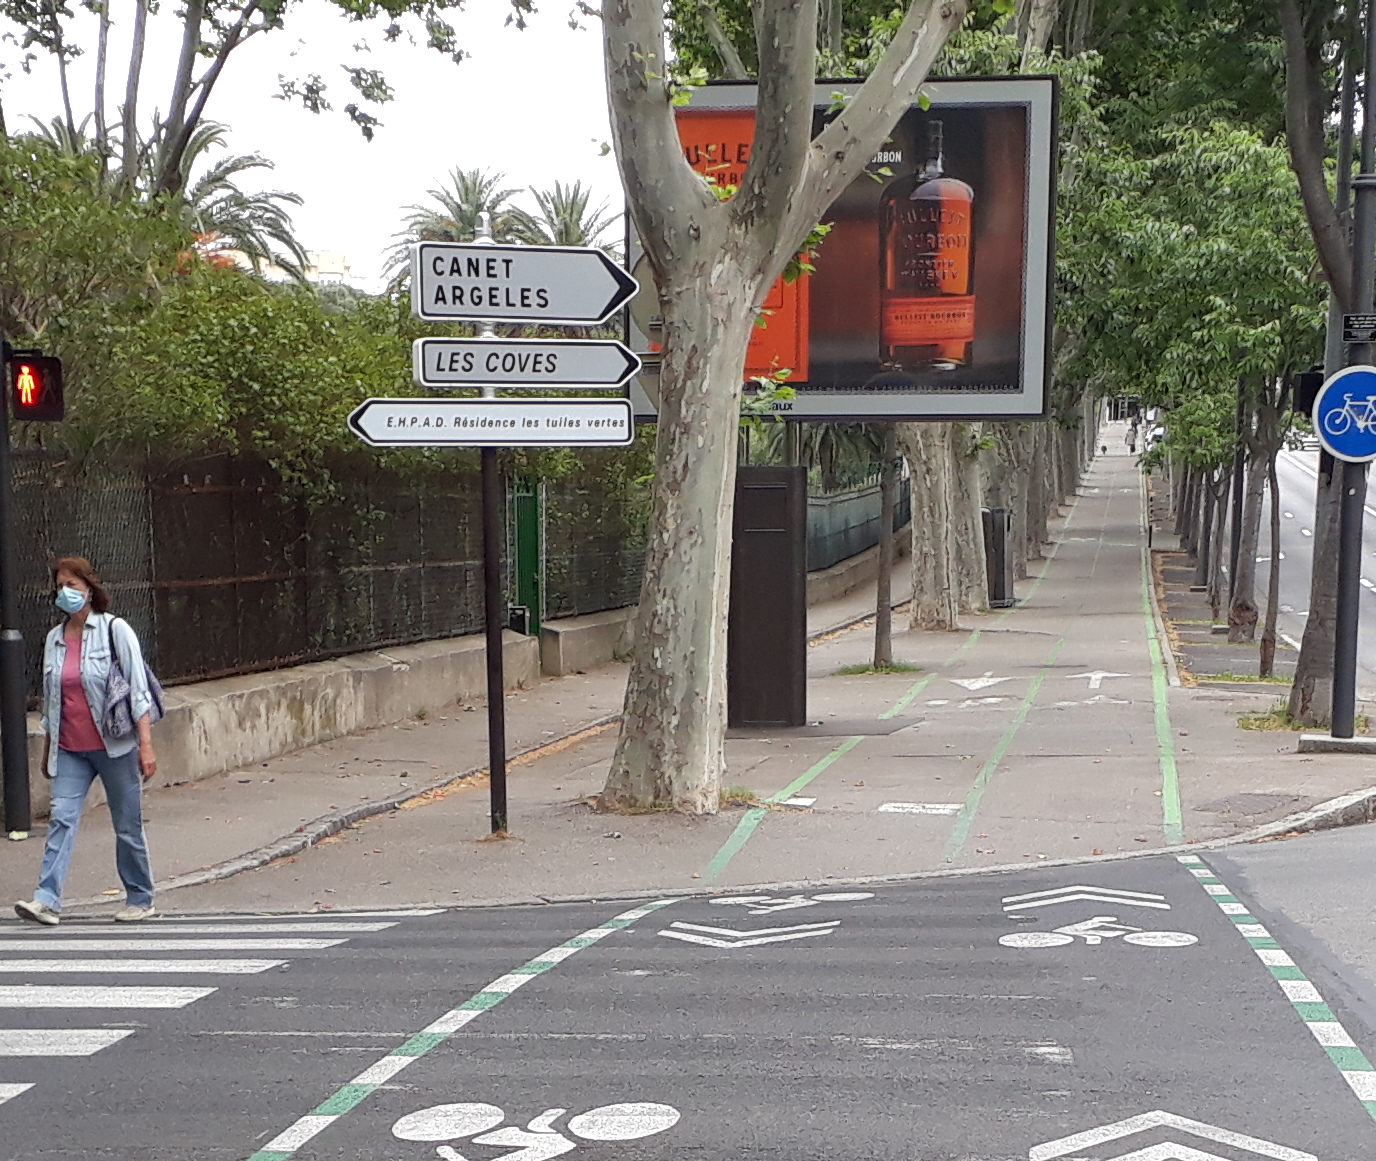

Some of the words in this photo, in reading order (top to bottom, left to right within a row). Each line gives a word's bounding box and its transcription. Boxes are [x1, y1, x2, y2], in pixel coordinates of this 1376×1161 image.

[685, 142, 749, 166] ULLE
[872, 151, 902, 163] RBON
[432, 255, 514, 279] CANET
[434, 284, 549, 308] ARGELES
[435, 351, 475, 373] LES
[485, 352, 558, 373] COVES
[453, 415, 516, 428] Résidence
[521, 417, 540, 428] les
[545, 416, 581, 428] tuiles
[587, 417, 625, 428] vertes
